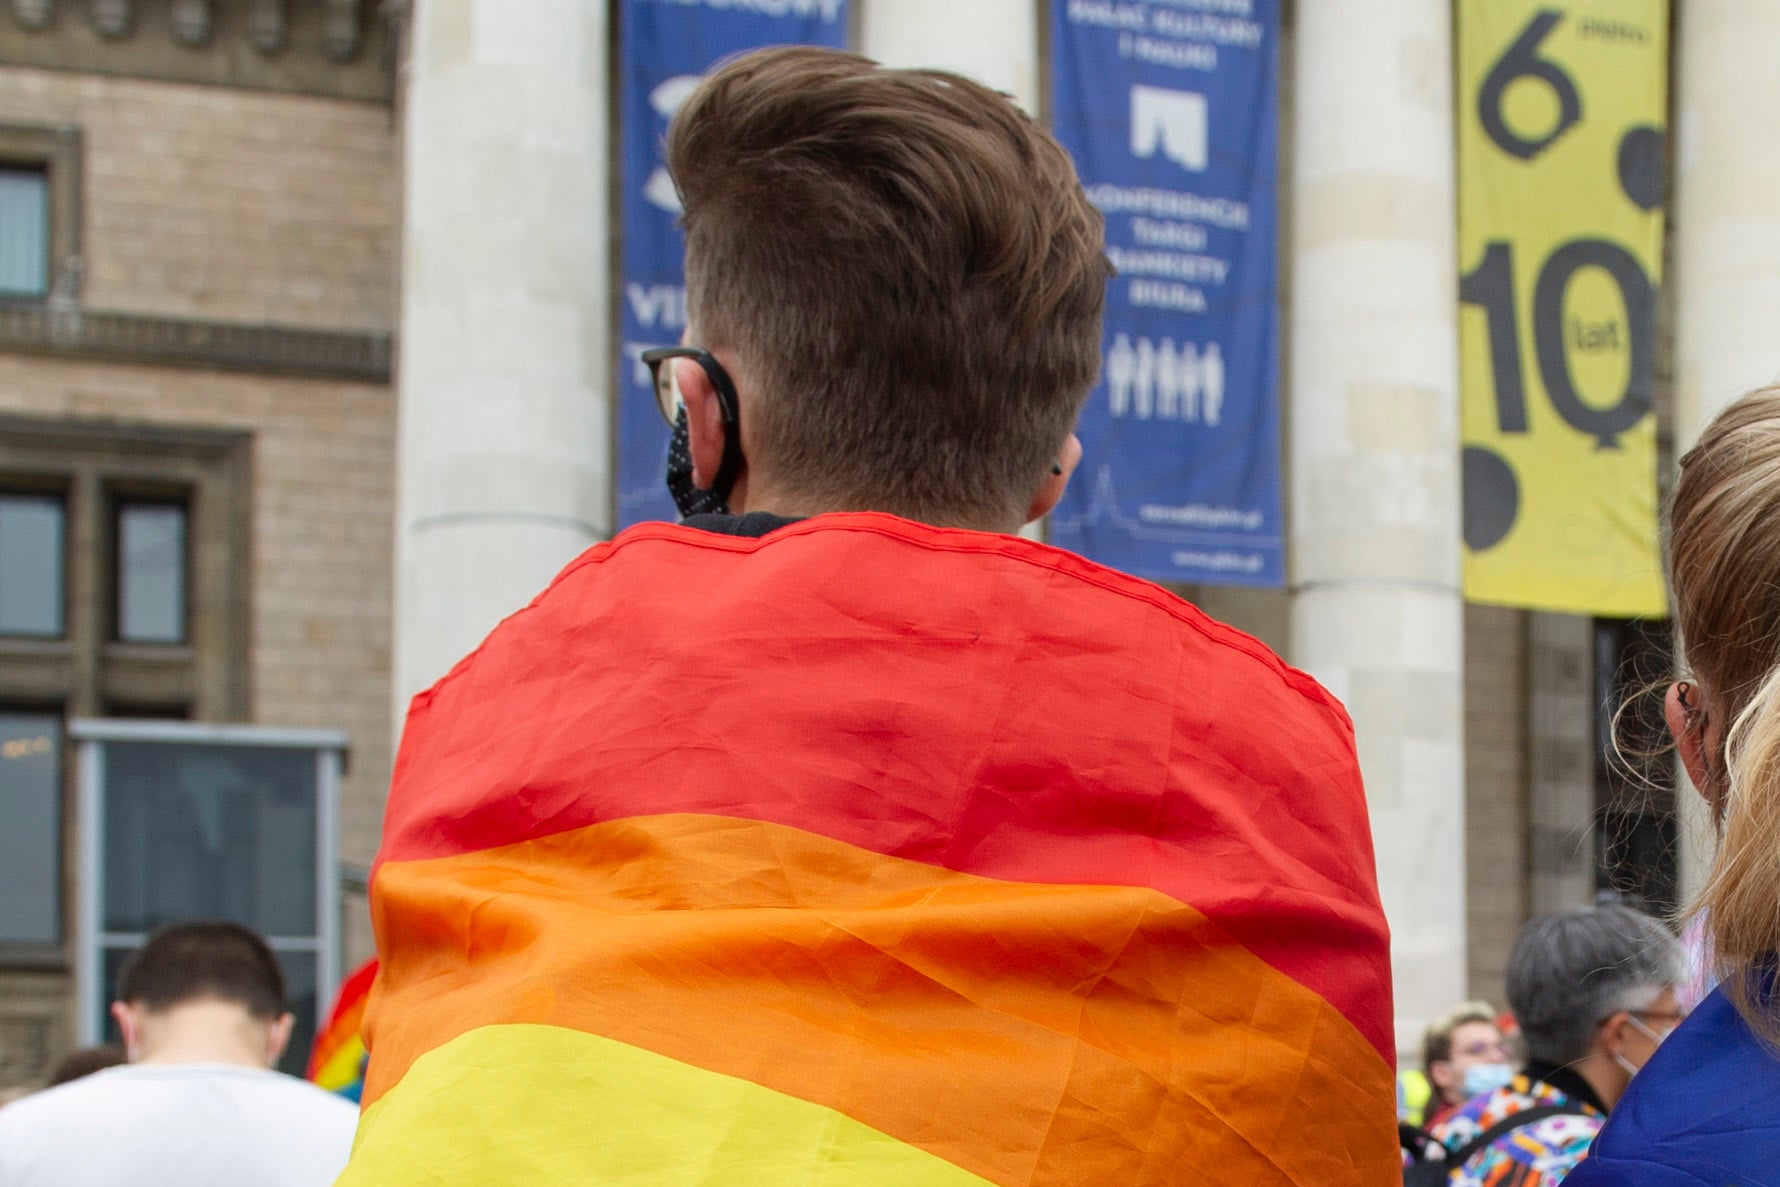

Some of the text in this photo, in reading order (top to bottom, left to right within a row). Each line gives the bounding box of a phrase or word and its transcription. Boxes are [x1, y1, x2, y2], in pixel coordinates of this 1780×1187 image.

[1135, 35, 1217, 70] NAUKI
[1478, 9, 1582, 160] 6
[1460, 239, 1657, 440] 10
[1572, 312, 1619, 351] lat
